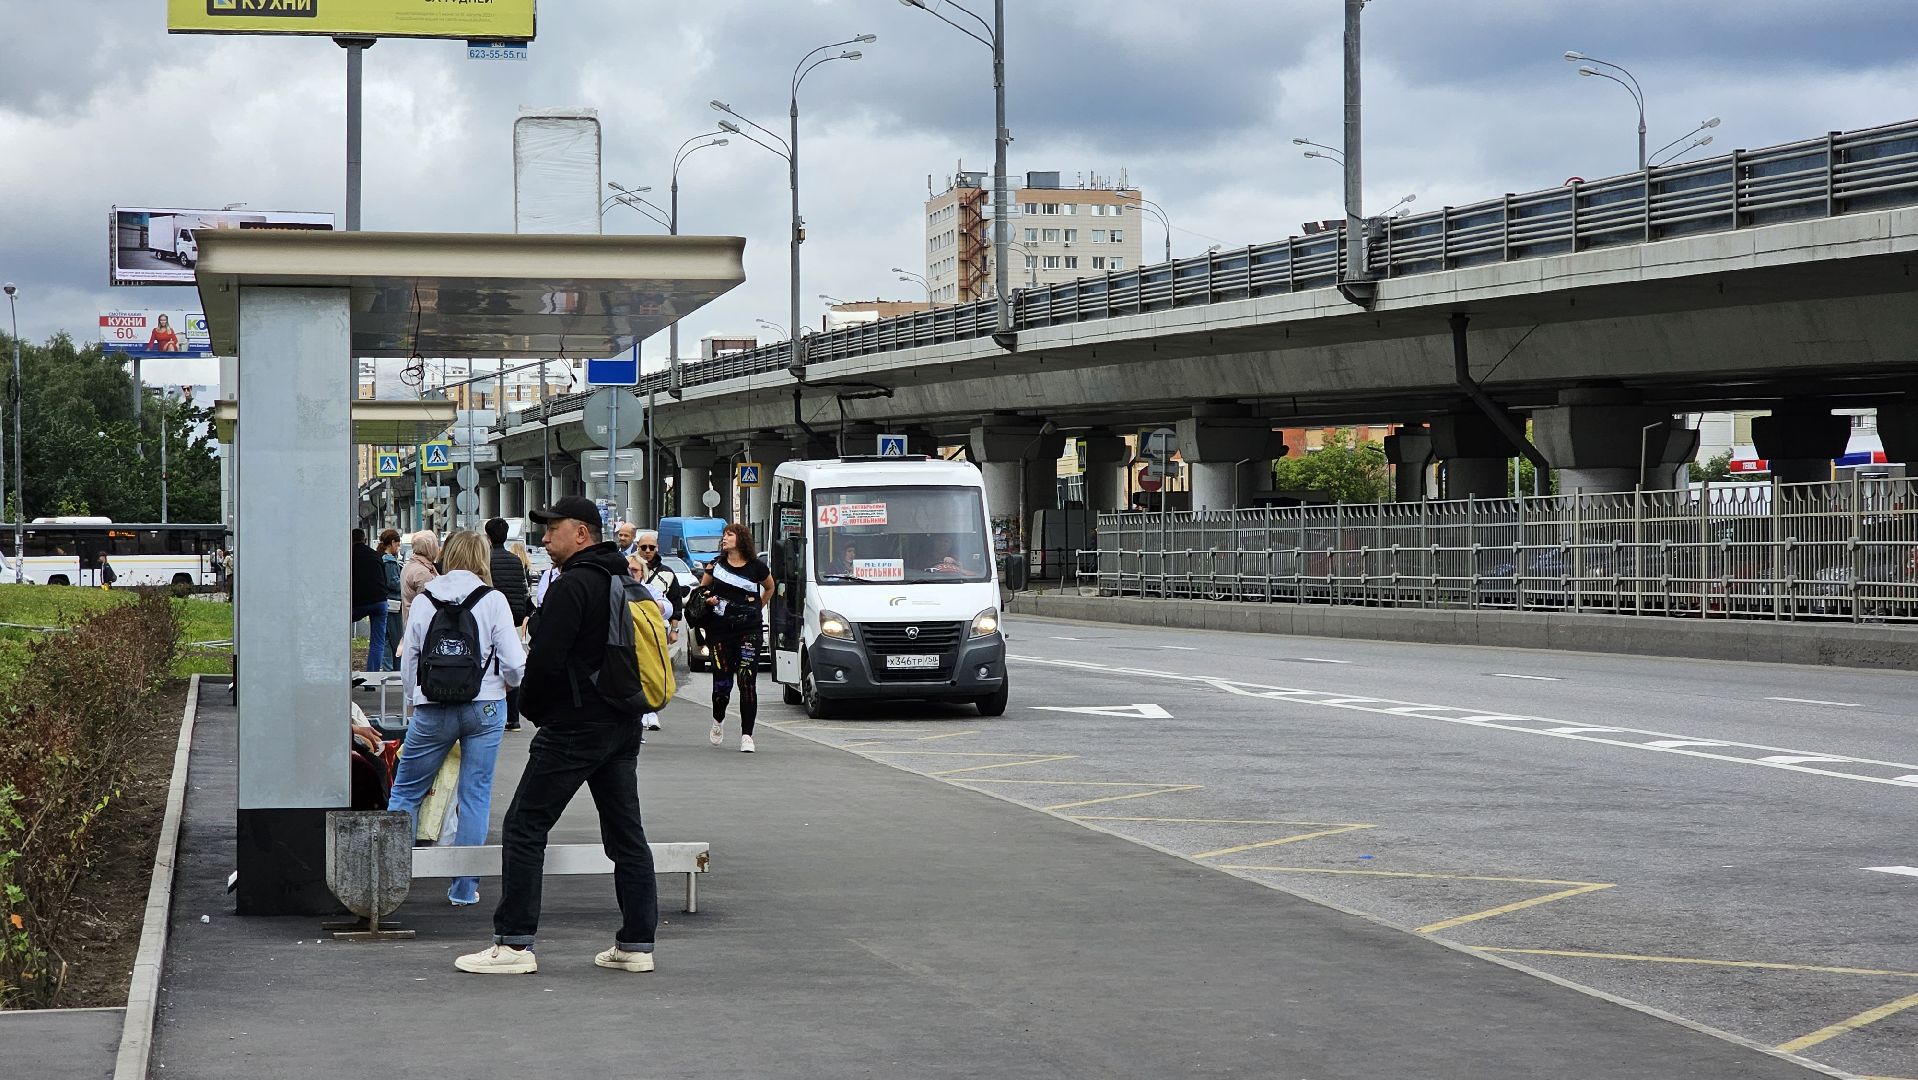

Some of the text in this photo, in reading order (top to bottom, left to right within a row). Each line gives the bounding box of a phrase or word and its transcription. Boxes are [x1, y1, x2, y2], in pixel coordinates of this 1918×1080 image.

[469, 49, 527, 59] 623-55-55.ru
[108, 317, 143, 326] КУХНИ
[820, 507, 838, 525] 43
[855, 567, 902, 577] КОТЕЛЬНИКИ
